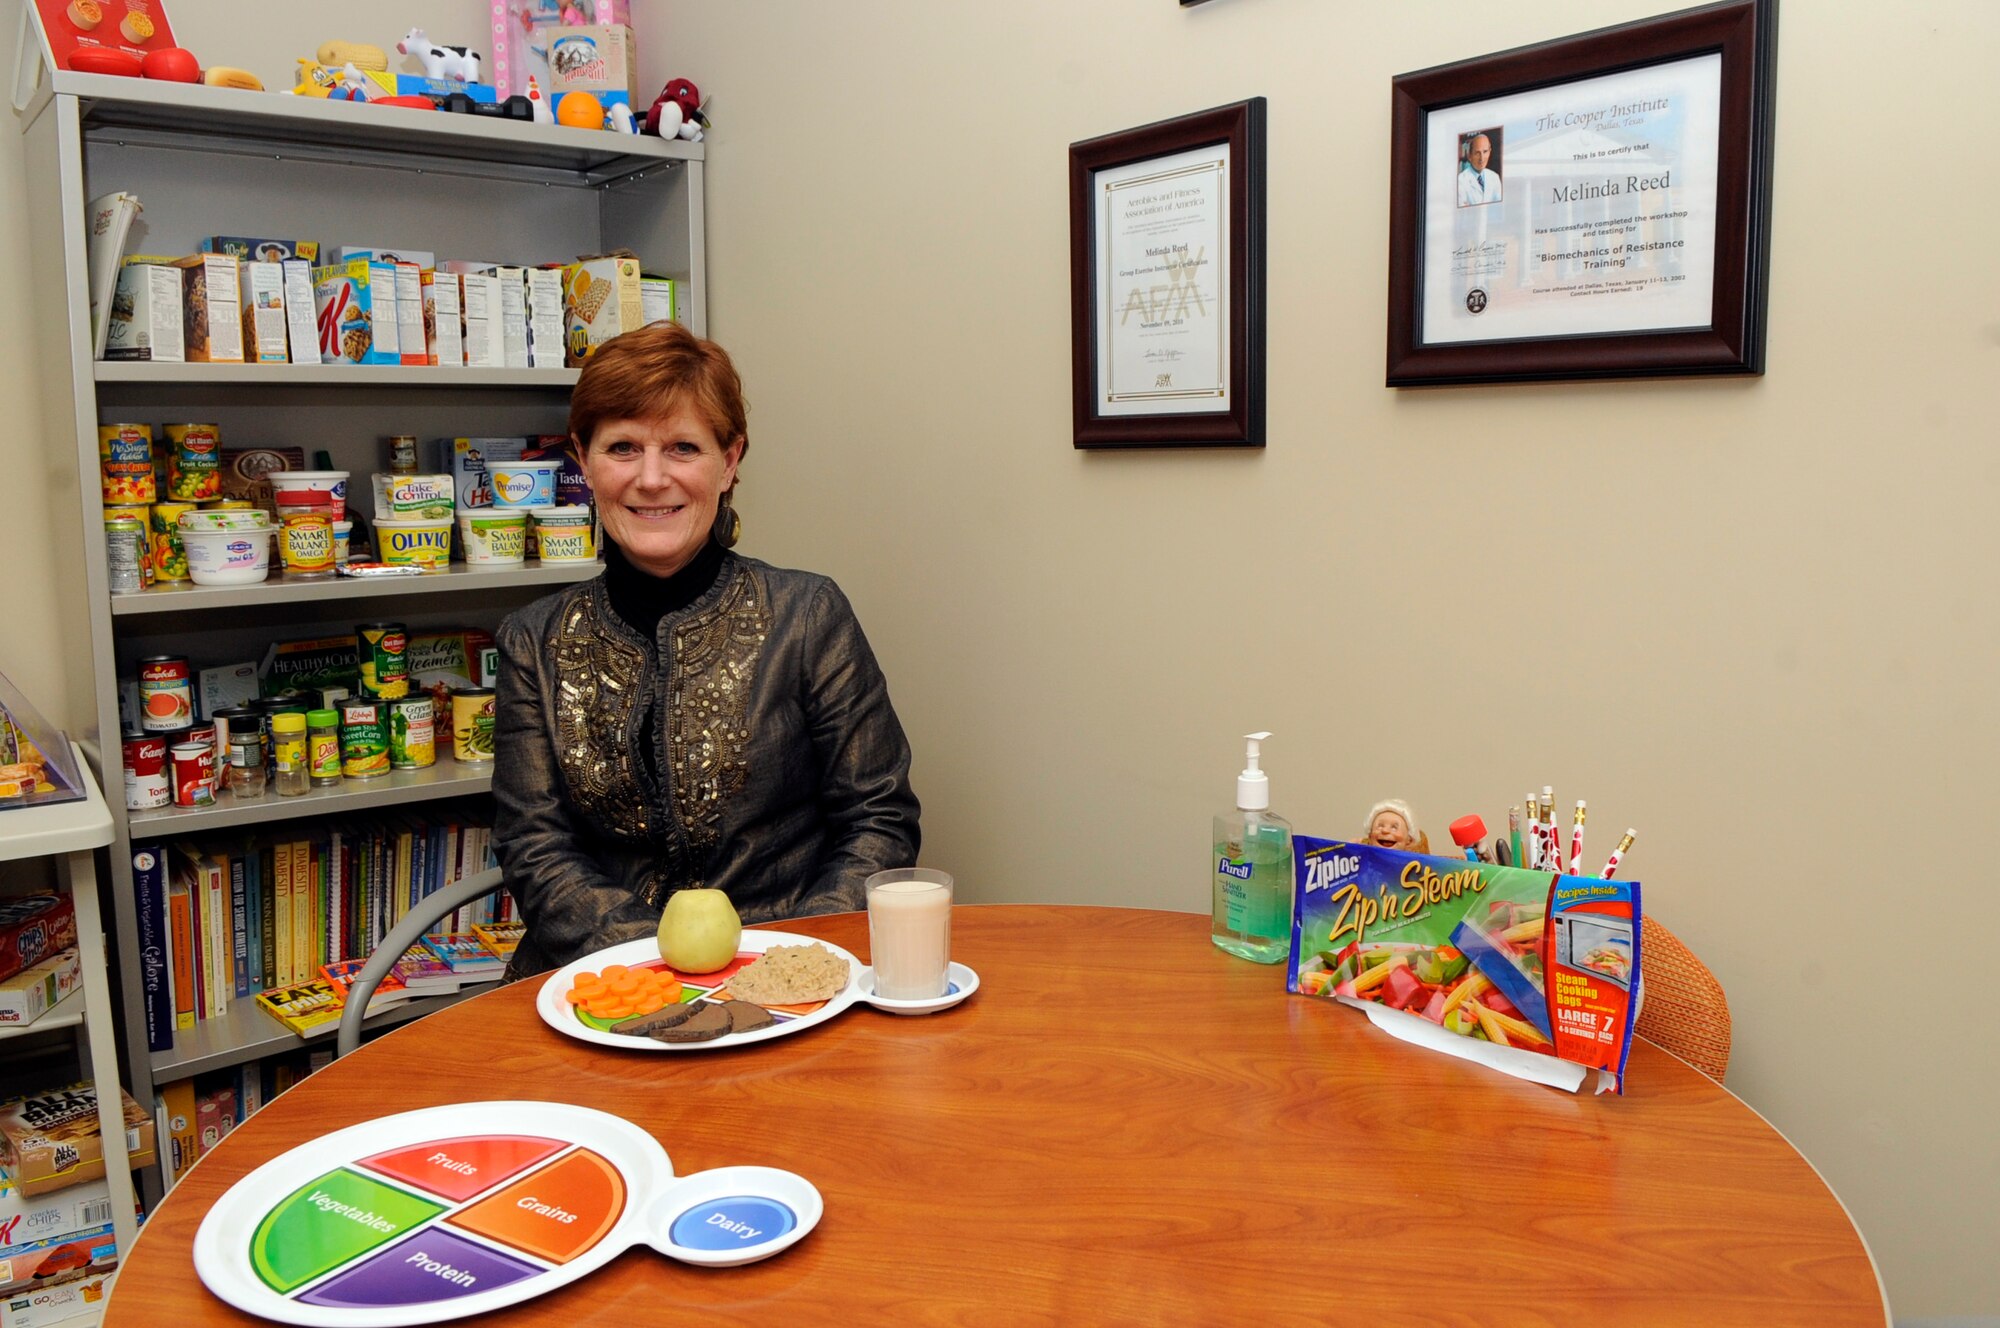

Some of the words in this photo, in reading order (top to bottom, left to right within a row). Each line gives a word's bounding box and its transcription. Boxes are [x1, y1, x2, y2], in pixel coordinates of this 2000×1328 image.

[1536, 112, 1560, 131] The
[1564, 108, 1607, 130] Cooper
[1610, 98, 1669, 118] Institute
[1623, 117, 1644, 127] Texas
[1573, 153, 1588, 161] This
[1607, 145, 1632, 156] certify
[1634, 143, 1650, 152] that
[1552, 178, 1620, 205] Melinda
[1626, 170, 1671, 194] Reed
[1127, 195, 1158, 207] Aerobics
[1159, 191, 1173, 201] and
[1175, 188, 1201, 199] Fitness
[1123, 205, 1164, 219] Association
[1165, 203, 1172, 212] of
[1175, 198, 1205, 210] America
[1550, 223, 1593, 233] successfully
[1594, 217, 1633, 229] completed
[1634, 215, 1647, 223] the
[1649, 210, 1688, 221] workshop
[1583, 230, 1596, 238] and
[1598, 227, 1624, 236] testing
[1625, 225, 1636, 233] for
[1145, 246, 1170, 257] Melinda
[1613, 246, 1624, 254] of
[1626, 239, 1685, 253] Resistance
[317, 282, 351, 357] K
[112, 443, 124, 453] No
[124, 443, 147, 455] Sugar
[405, 483, 432, 492] Take
[497, 480, 532, 492] Promise
[560, 472, 586, 485] Taste
[288, 529, 329, 540] SMART
[391, 531, 449, 551] OLIVIO
[544, 536, 583, 547] SMART
[288, 541, 329, 550] BALANCE
[546, 547, 582, 557] BALANCE
[274, 658, 323, 673] HEALTHY
[330, 653, 358, 667] CHO
[409, 654, 464, 671] teamers
[405, 704, 432, 713] Green
[408, 711, 433, 720] Giant
[276, 851, 288, 898] DIABESITY
[295, 848, 307, 895] DIABESITY
[1221, 859, 1249, 878] Purell
[1304, 855, 1359, 893] Ziploc
[140, 874, 151, 898] Fruits
[232, 862, 244, 894] NUTRITION
[1226, 880, 1242, 891] HAND
[1222, 885, 1247, 900] SANITIZER
[1401, 860, 1487, 917] Steam
[1557, 886, 1589, 899] Recipes
[1590, 885, 1618, 896] Inside
[234, 894, 244, 906] FOR
[141, 905, 154, 946] Vegetables
[234, 907, 245, 931] SERIOUS
[264, 919, 272, 939] GUIDE
[235, 931, 246, 958] ATHLETES
[265, 945, 273, 973] DIABETES
[141, 946, 163, 992] Galore
[1556, 972, 1588, 986] Steam
[1556, 983, 1598, 999] Cooking
[1557, 994, 1582, 1007] Bags
[1557, 1008, 1597, 1025] LARGE
[1603, 1016, 1614, 1032] 7
[427, 1152, 478, 1177] Fruits
[27, 1212, 62, 1227] CHIPS
[30, 1208, 58, 1219] cracker
[306, 1190, 397, 1234] Vegetables
[516, 1197, 578, 1225] Grains
[705, 1212, 762, 1240] Dairy
[405, 1251, 477, 1288] Protein
